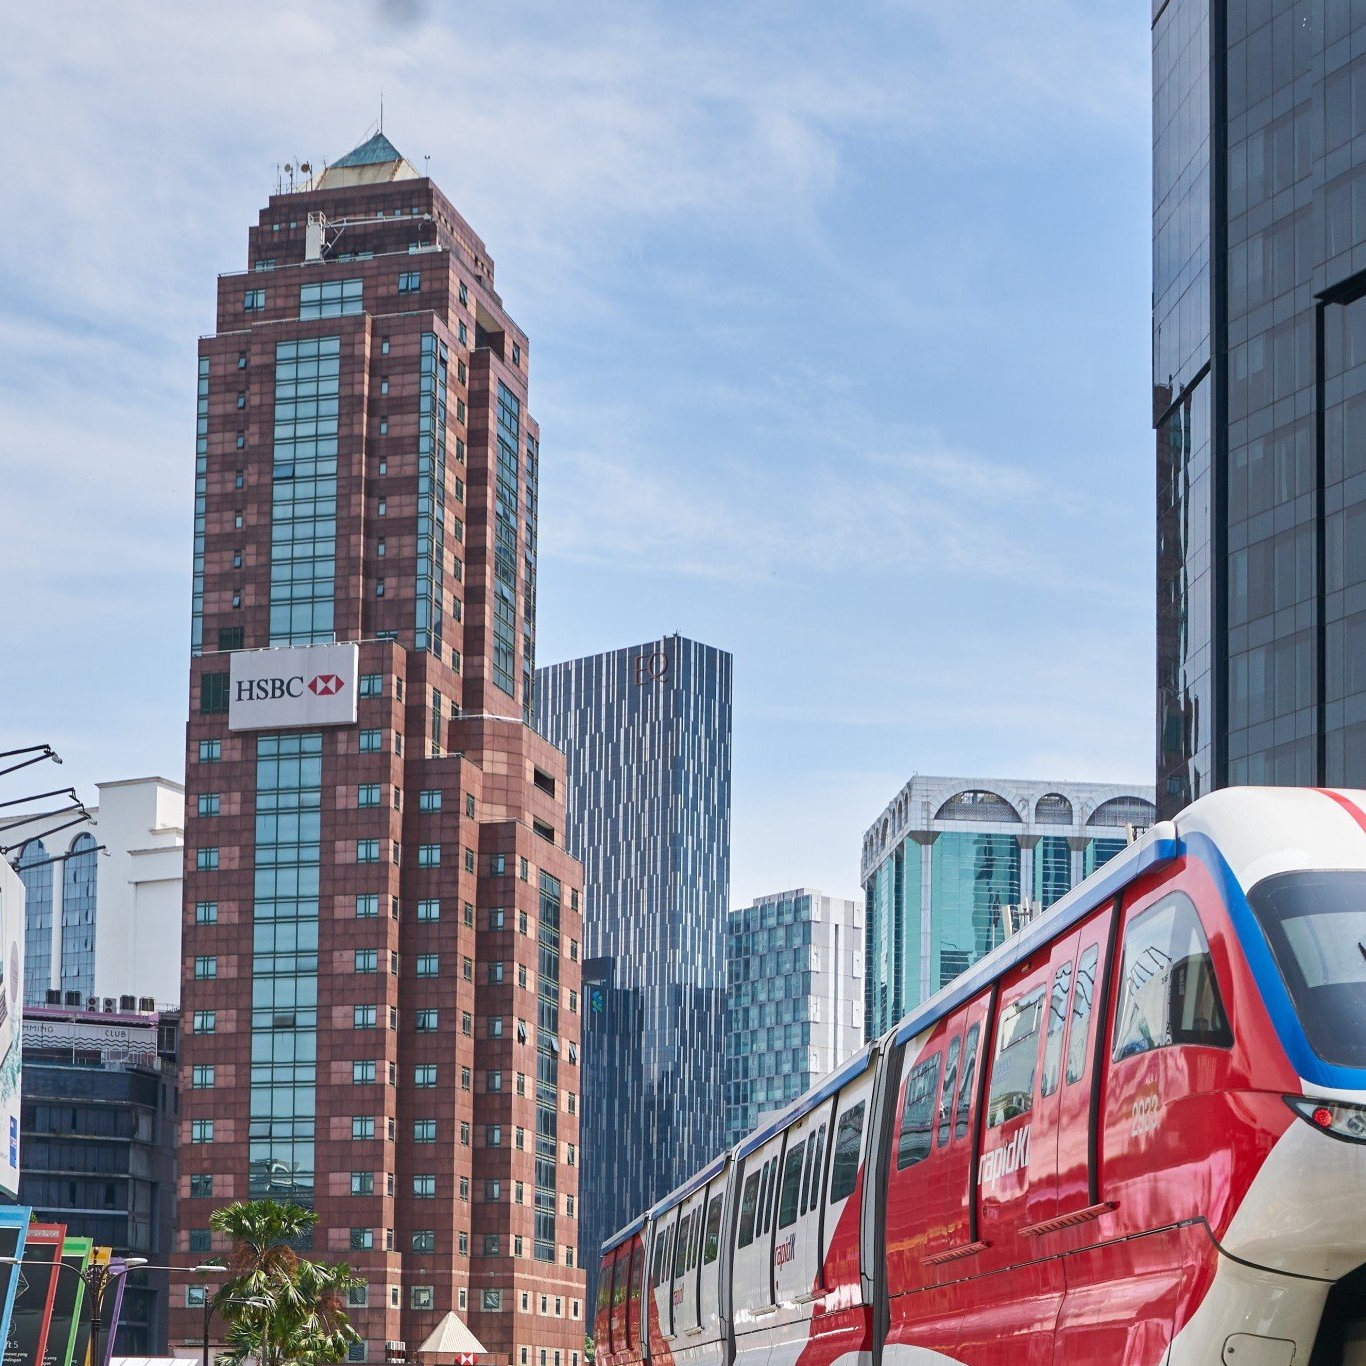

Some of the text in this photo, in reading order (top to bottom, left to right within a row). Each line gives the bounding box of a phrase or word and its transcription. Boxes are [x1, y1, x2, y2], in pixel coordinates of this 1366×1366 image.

[235, 675, 304, 702] HSBC
[104, 1029, 127, 1038] CLUB
[1131, 1094, 1161, 1138] 2933
